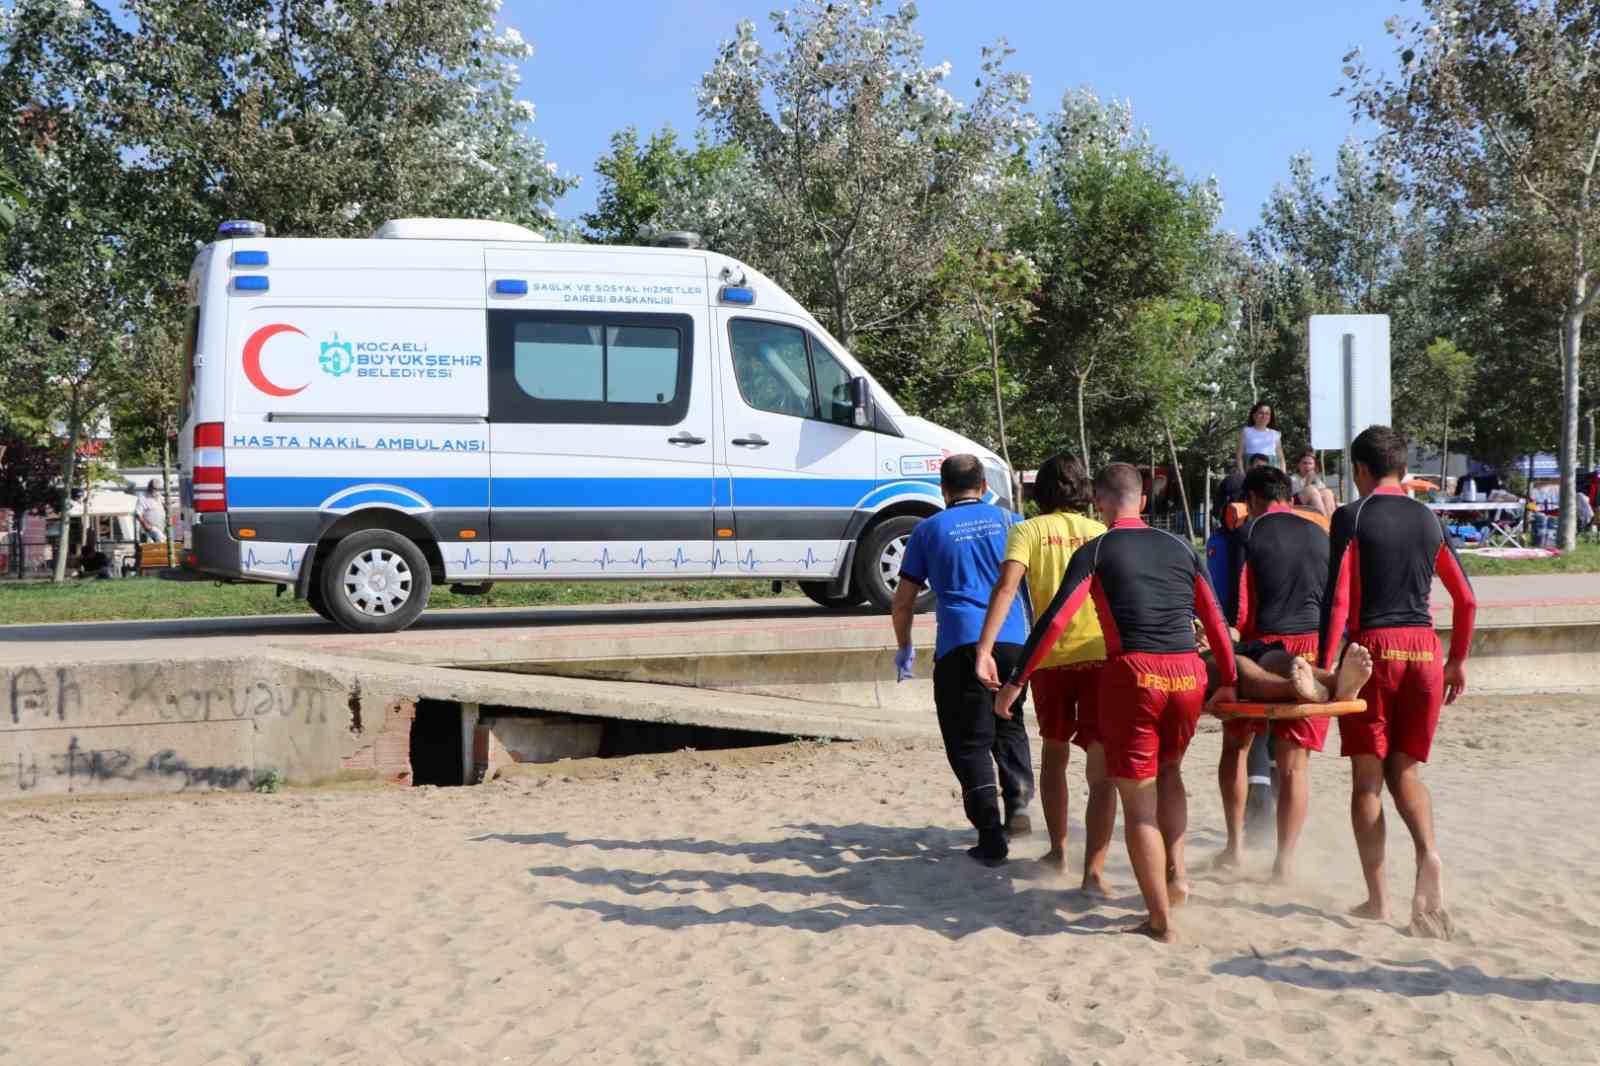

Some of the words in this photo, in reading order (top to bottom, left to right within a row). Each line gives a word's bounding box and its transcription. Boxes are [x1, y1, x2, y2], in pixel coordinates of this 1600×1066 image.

[577, 284, 591, 292] VE
[233, 435, 301, 448] HASTA
[375, 438, 485, 451] AMBULANSI
[1381, 649, 1434, 662] LIFEGUARD
[1136, 672, 1197, 692] LIFEGUARD
